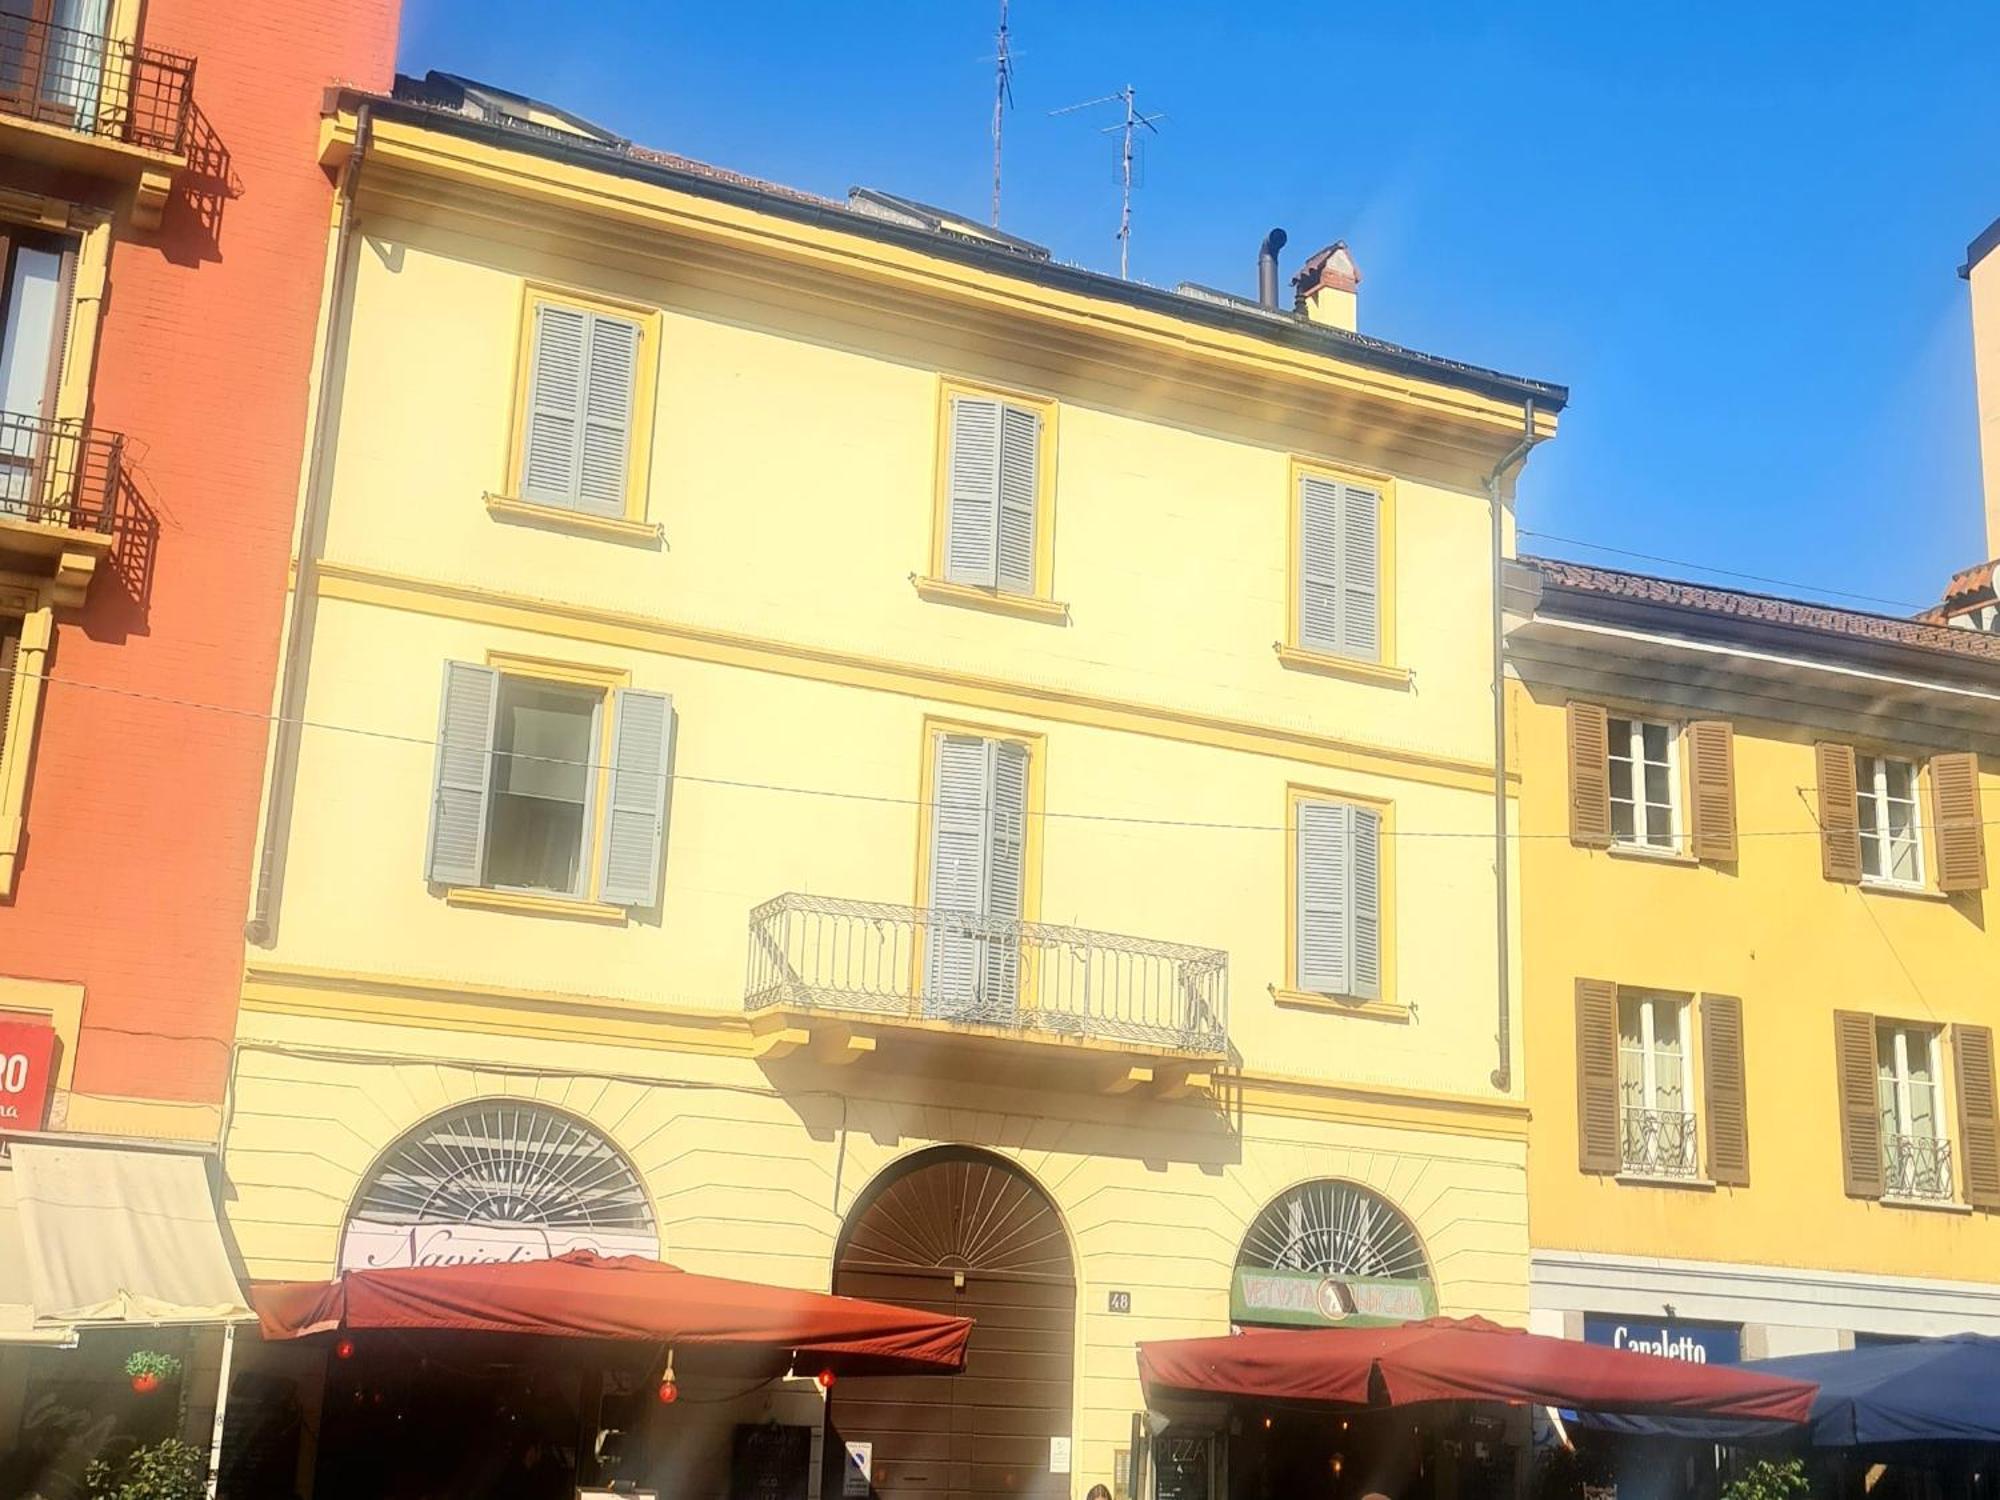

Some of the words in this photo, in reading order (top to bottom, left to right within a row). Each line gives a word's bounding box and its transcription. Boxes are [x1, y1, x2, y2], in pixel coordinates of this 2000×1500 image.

[367, 1227, 530, 1267] Navil
[1111, 1293, 1129, 1309] 48
[1614, 1326, 1706, 1365] Canaletto
[1157, 1438, 1207, 1462] PIZZA
